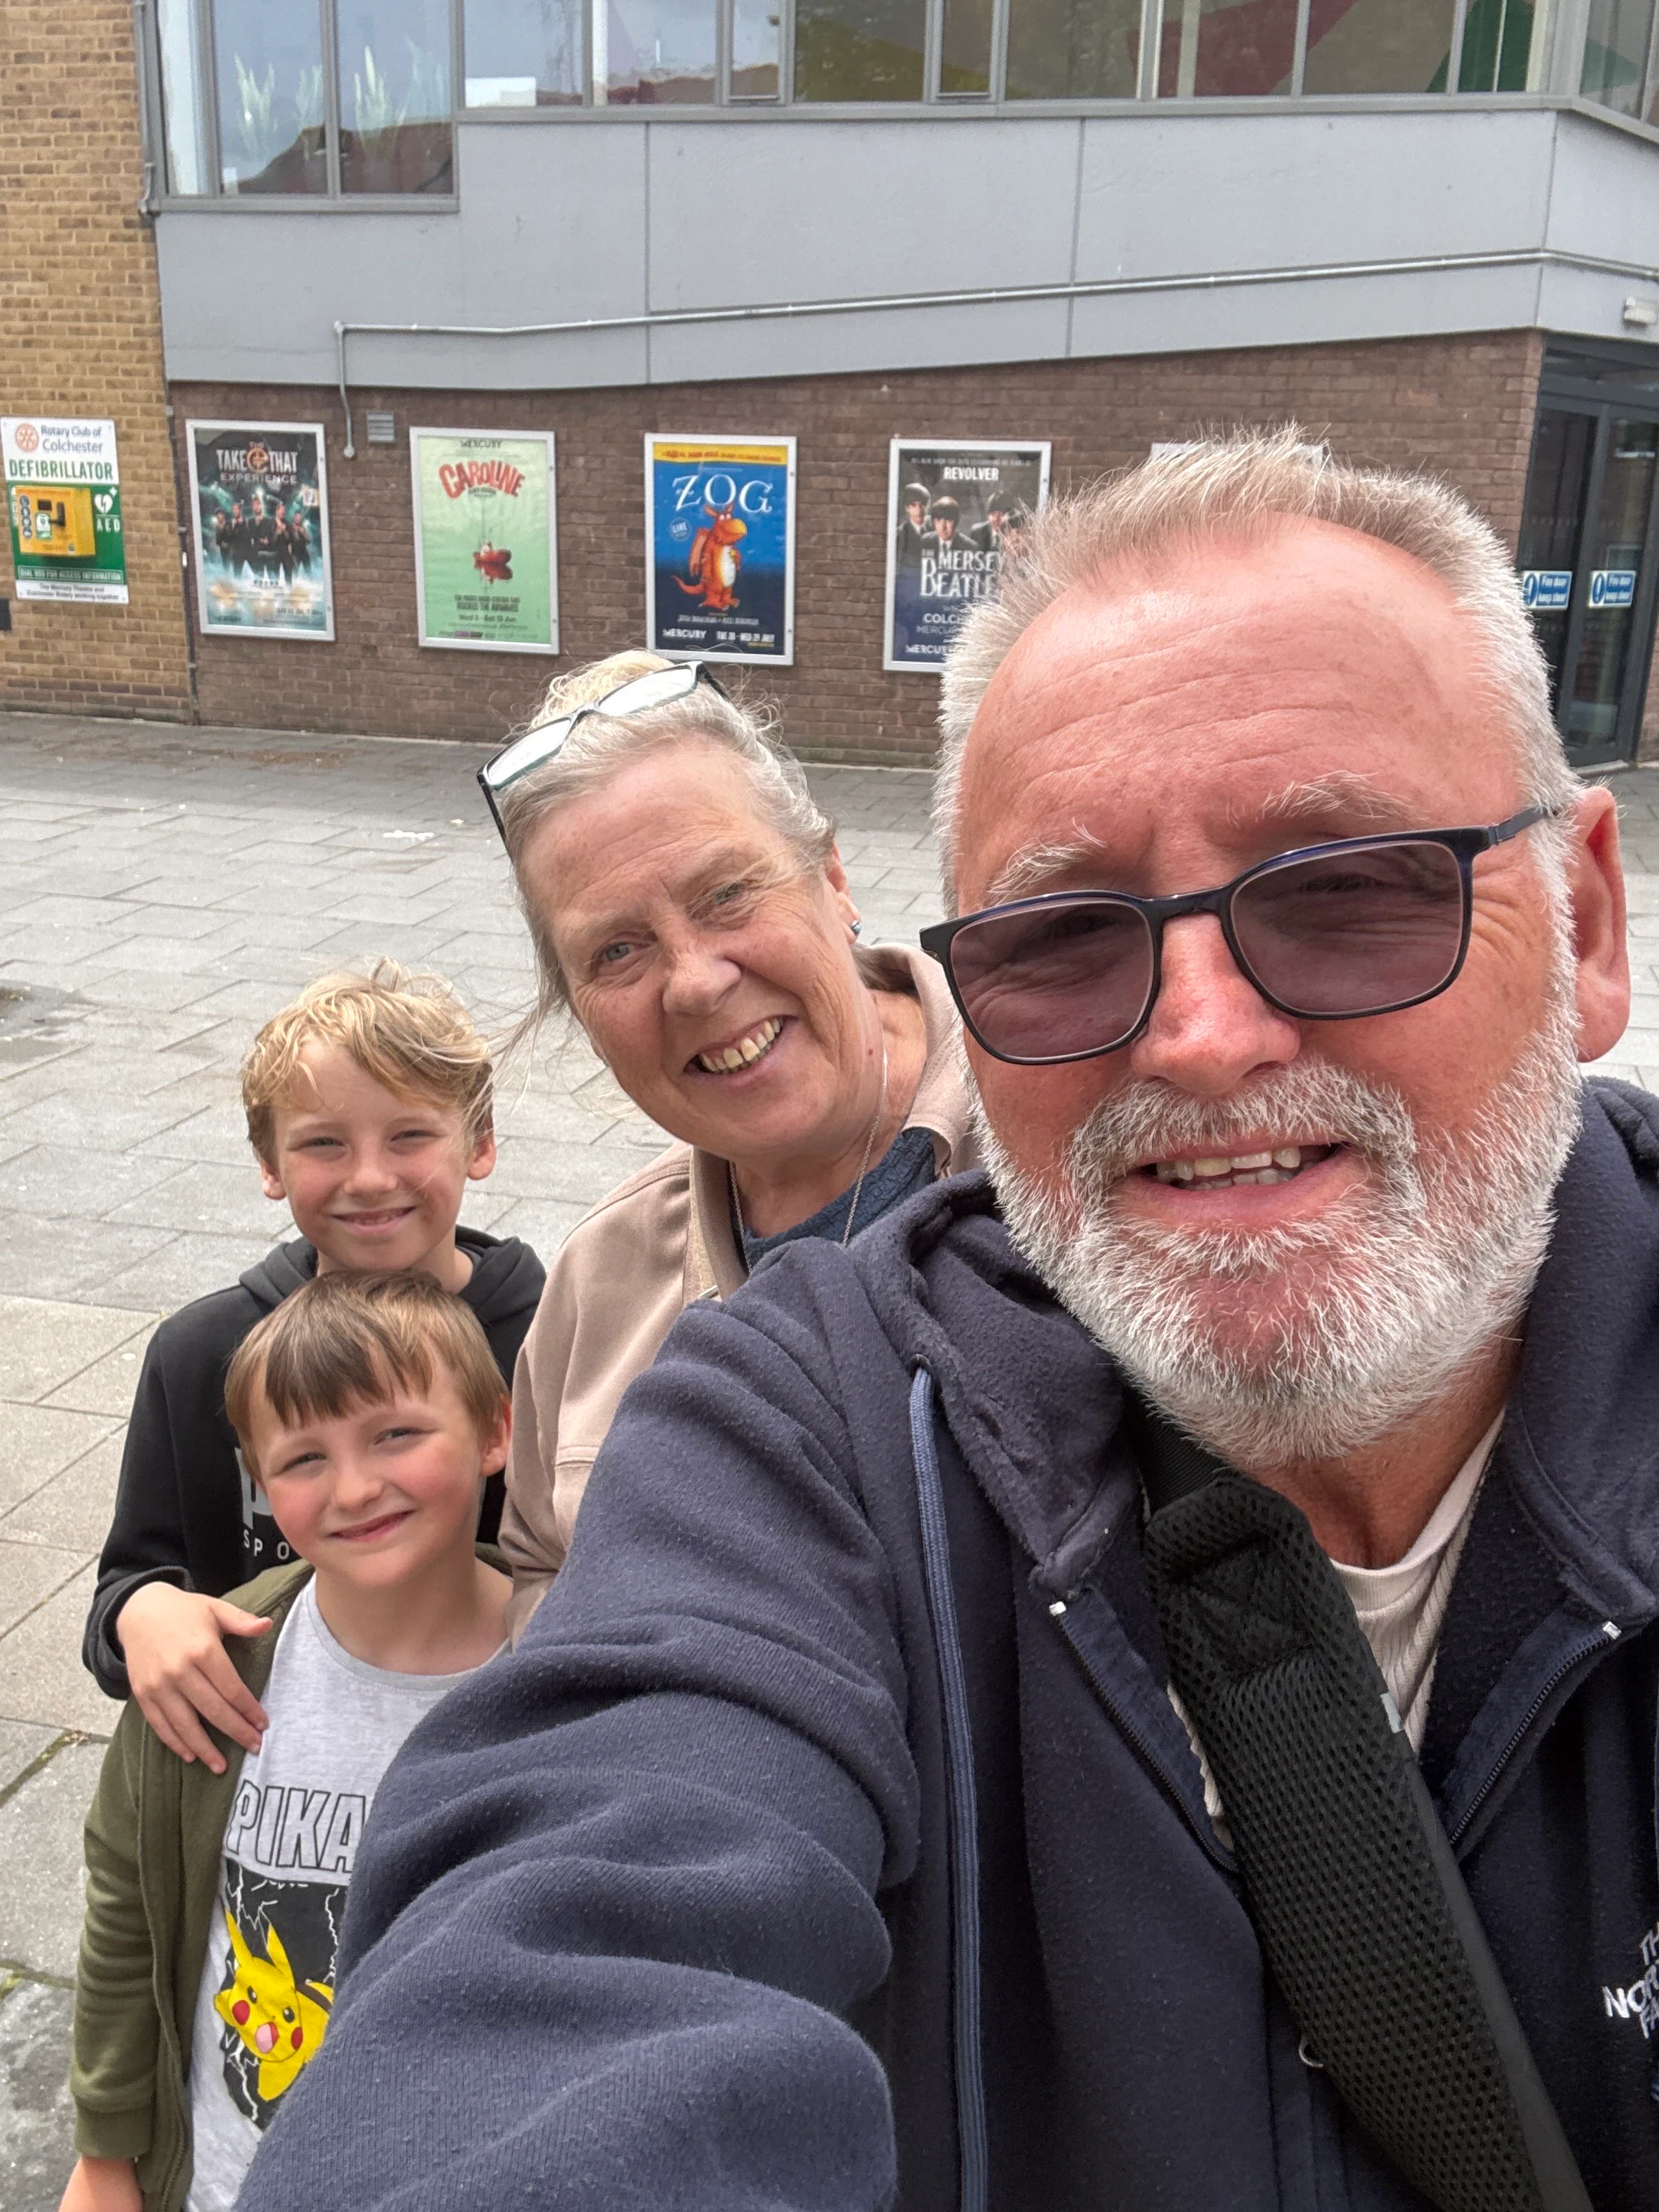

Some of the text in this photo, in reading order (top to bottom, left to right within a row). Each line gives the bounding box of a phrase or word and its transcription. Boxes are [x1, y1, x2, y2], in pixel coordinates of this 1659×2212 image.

[41, 425, 102, 438] Rotary Club of
[42, 438, 102, 453] Colchester
[461, 438, 502, 448] MERCURY
[216, 449, 298, 473] TAKE THAT
[9, 458, 114, 480] DEFIBRILLATOR
[943, 467, 999, 481] REVOLVER
[220, 473, 298, 484] EXPERIENCE
[438, 459, 526, 499] CAROLINE
[671, 473, 774, 514] ZOG
[97, 518, 120, 533] AED
[82, 571, 121, 580] INFORMATION
[920, 557, 999, 598] BEATLE
[663, 627, 707, 639] MERCURY
[1602, 1959, 1659, 2019] NOR
